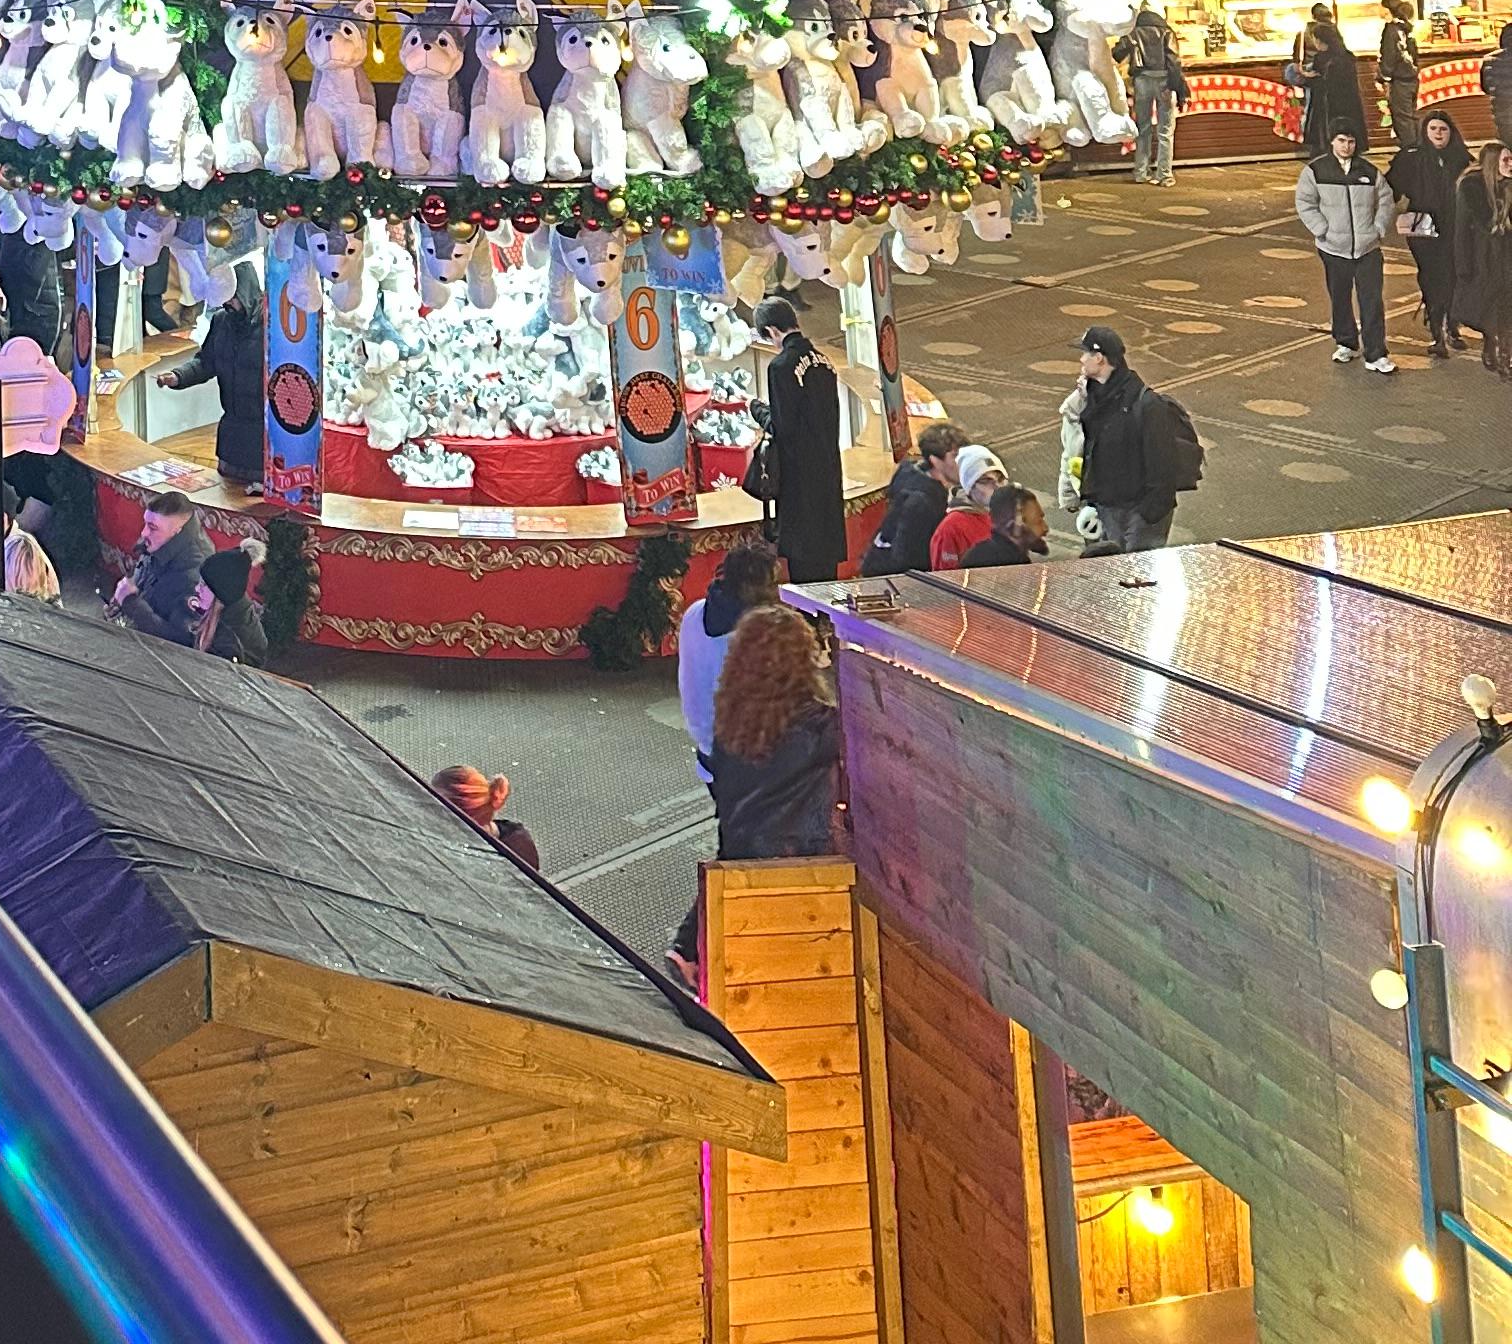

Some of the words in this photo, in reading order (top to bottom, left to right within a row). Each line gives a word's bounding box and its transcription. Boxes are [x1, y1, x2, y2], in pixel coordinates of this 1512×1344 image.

[661, 267, 679, 281] TO
[679, 270, 706, 281] WIN
[626, 286, 660, 351] 6
